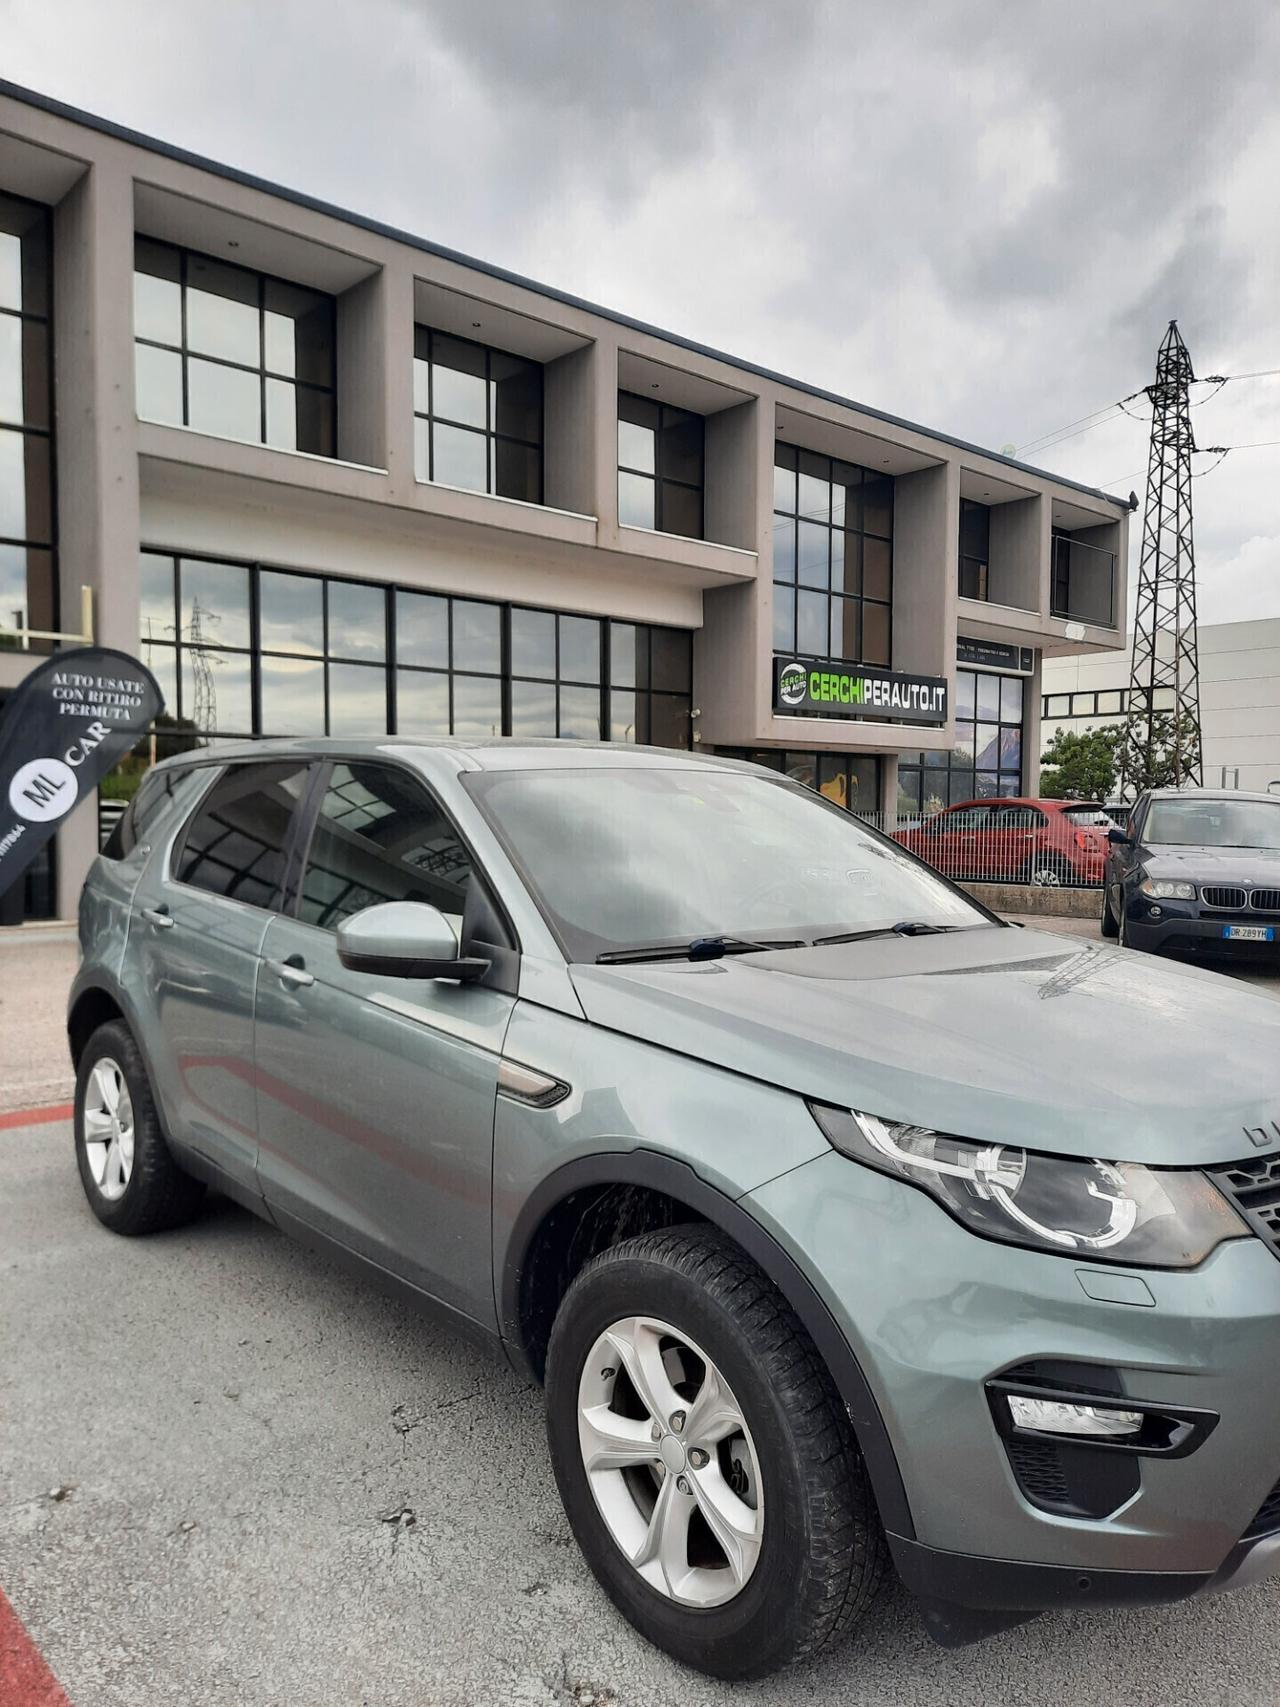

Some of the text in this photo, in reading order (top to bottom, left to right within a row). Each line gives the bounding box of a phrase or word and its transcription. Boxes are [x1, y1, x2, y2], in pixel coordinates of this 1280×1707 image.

[52, 672, 145, 695] AUTO USATE
[780, 671, 807, 688] CERCHI
[780, 680, 807, 695] PER AUTO
[52, 686, 142, 707] CON RITIRO
[809, 671, 946, 712] CERCHIPERAUTO.IT
[59, 702, 130, 720] PERMUTA
[22, 720, 112, 809] ML CAR
